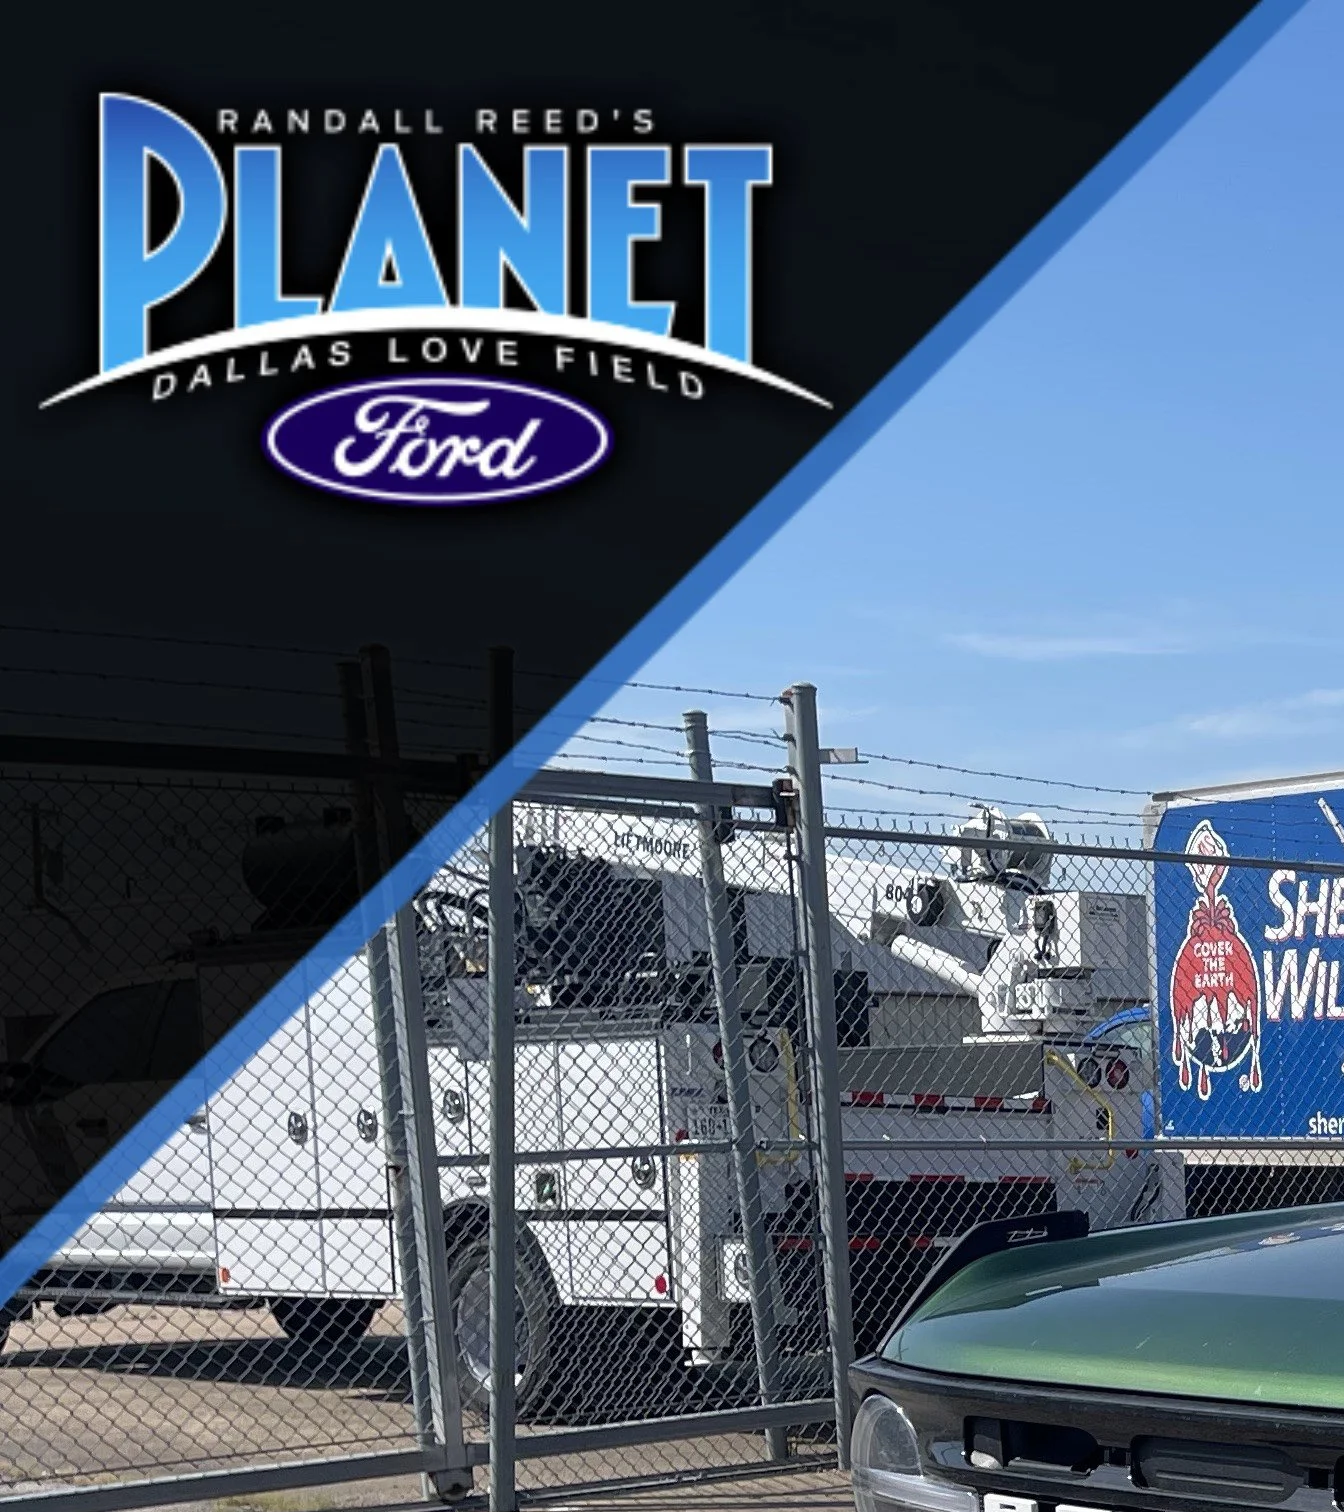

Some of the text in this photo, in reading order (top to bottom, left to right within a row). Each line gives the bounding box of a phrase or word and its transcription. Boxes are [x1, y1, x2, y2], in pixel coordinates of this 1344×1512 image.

[1193, 941, 1233, 956] COVER
[1202, 957, 1226, 972] THE
[1194, 973, 1234, 989] EARTH
